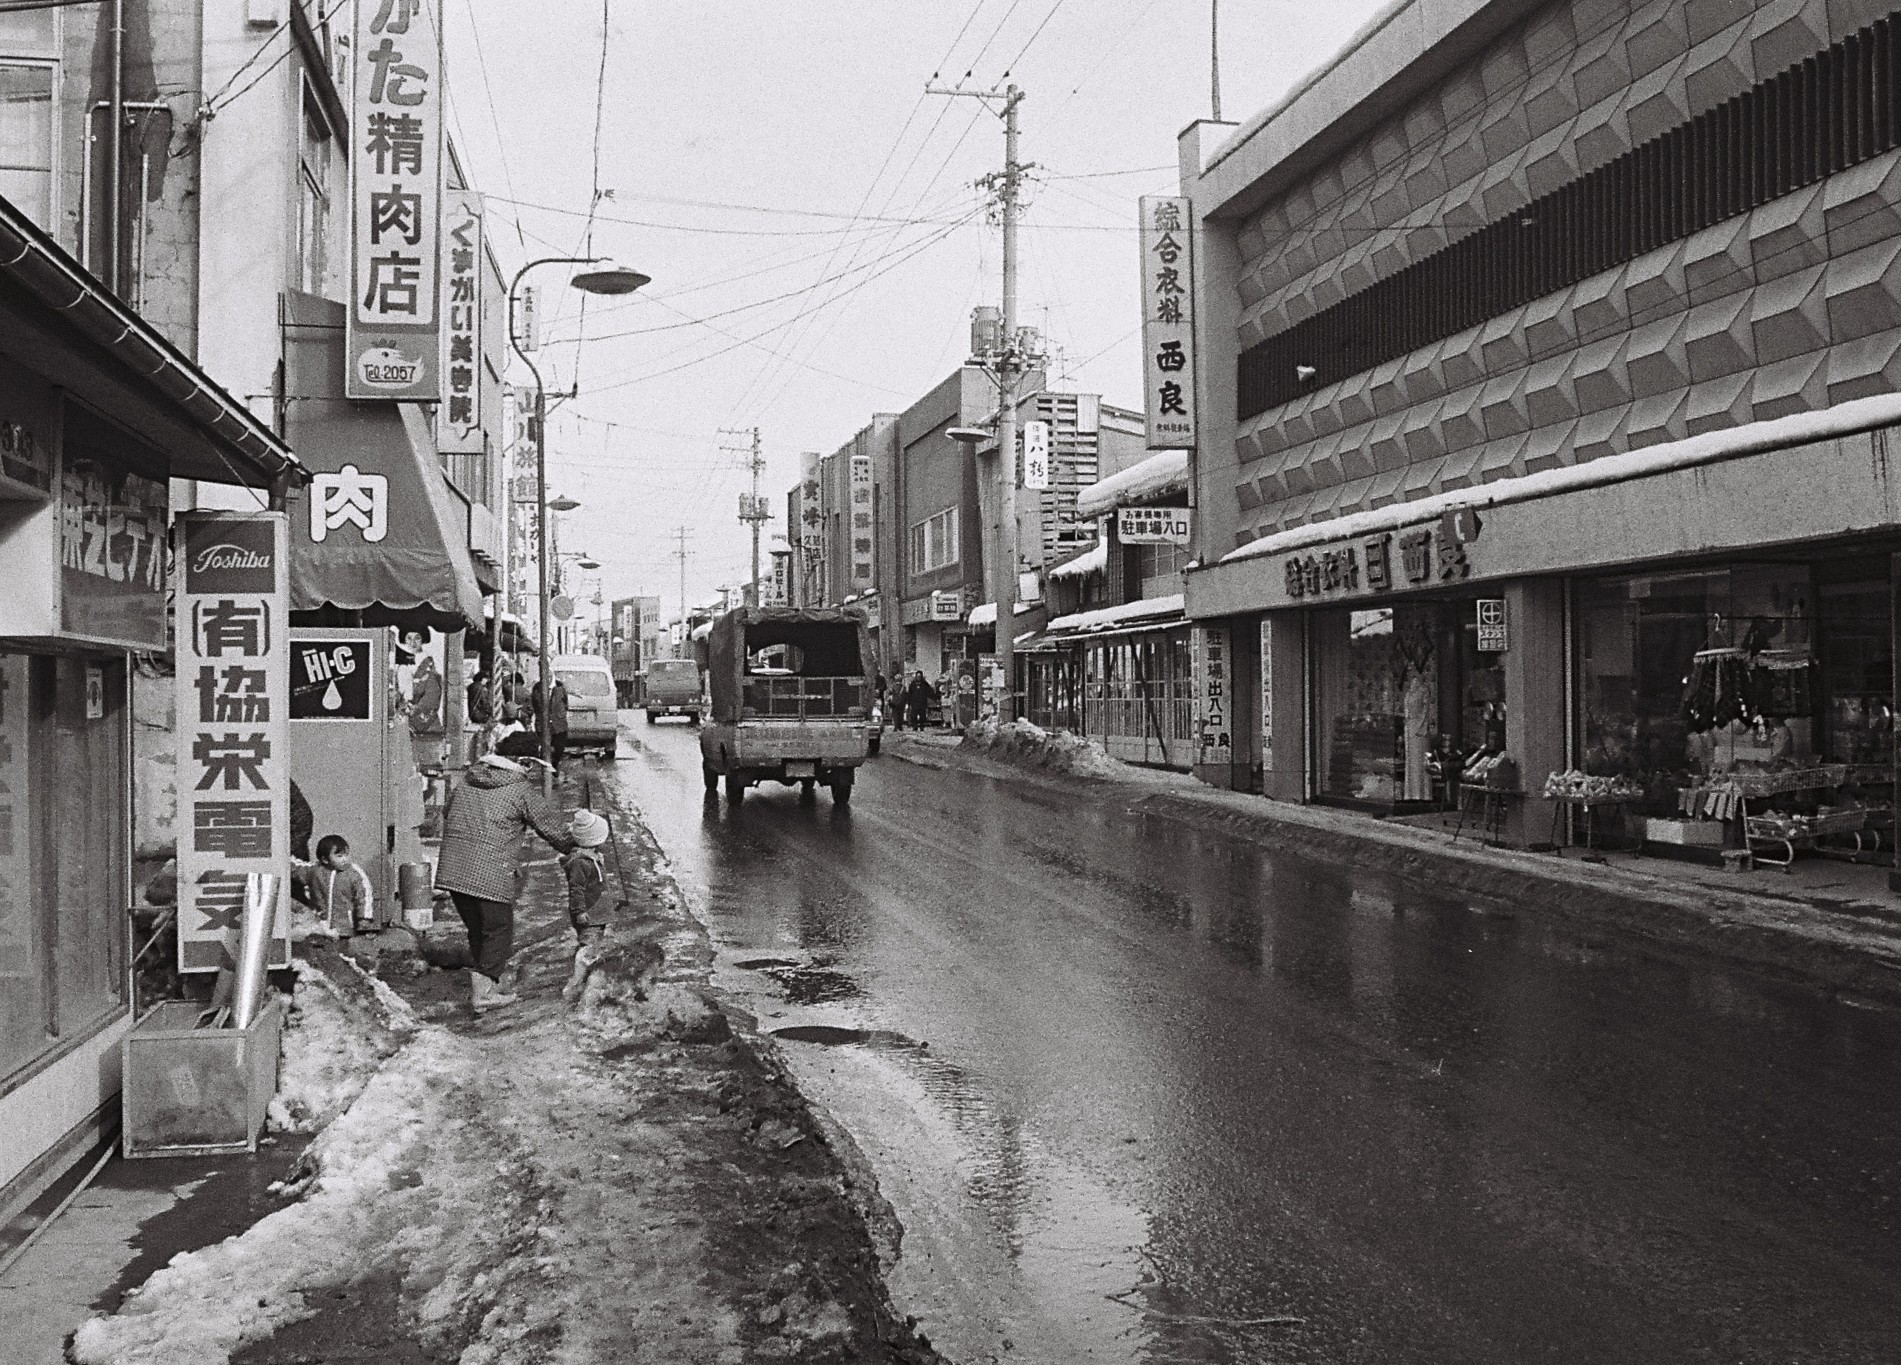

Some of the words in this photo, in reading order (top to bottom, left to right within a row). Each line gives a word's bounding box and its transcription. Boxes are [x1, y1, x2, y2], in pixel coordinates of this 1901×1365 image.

[383, 364, 416, 381] 2057
[1156, 340, 1187, 415] 西良
[309, 464, 388, 543] 肉
[1121, 520, 1188, 536] 駐車場入口
[193, 545, 270, 573] Toshiba
[1206, 630, 1224, 727] 駐車場出入口
